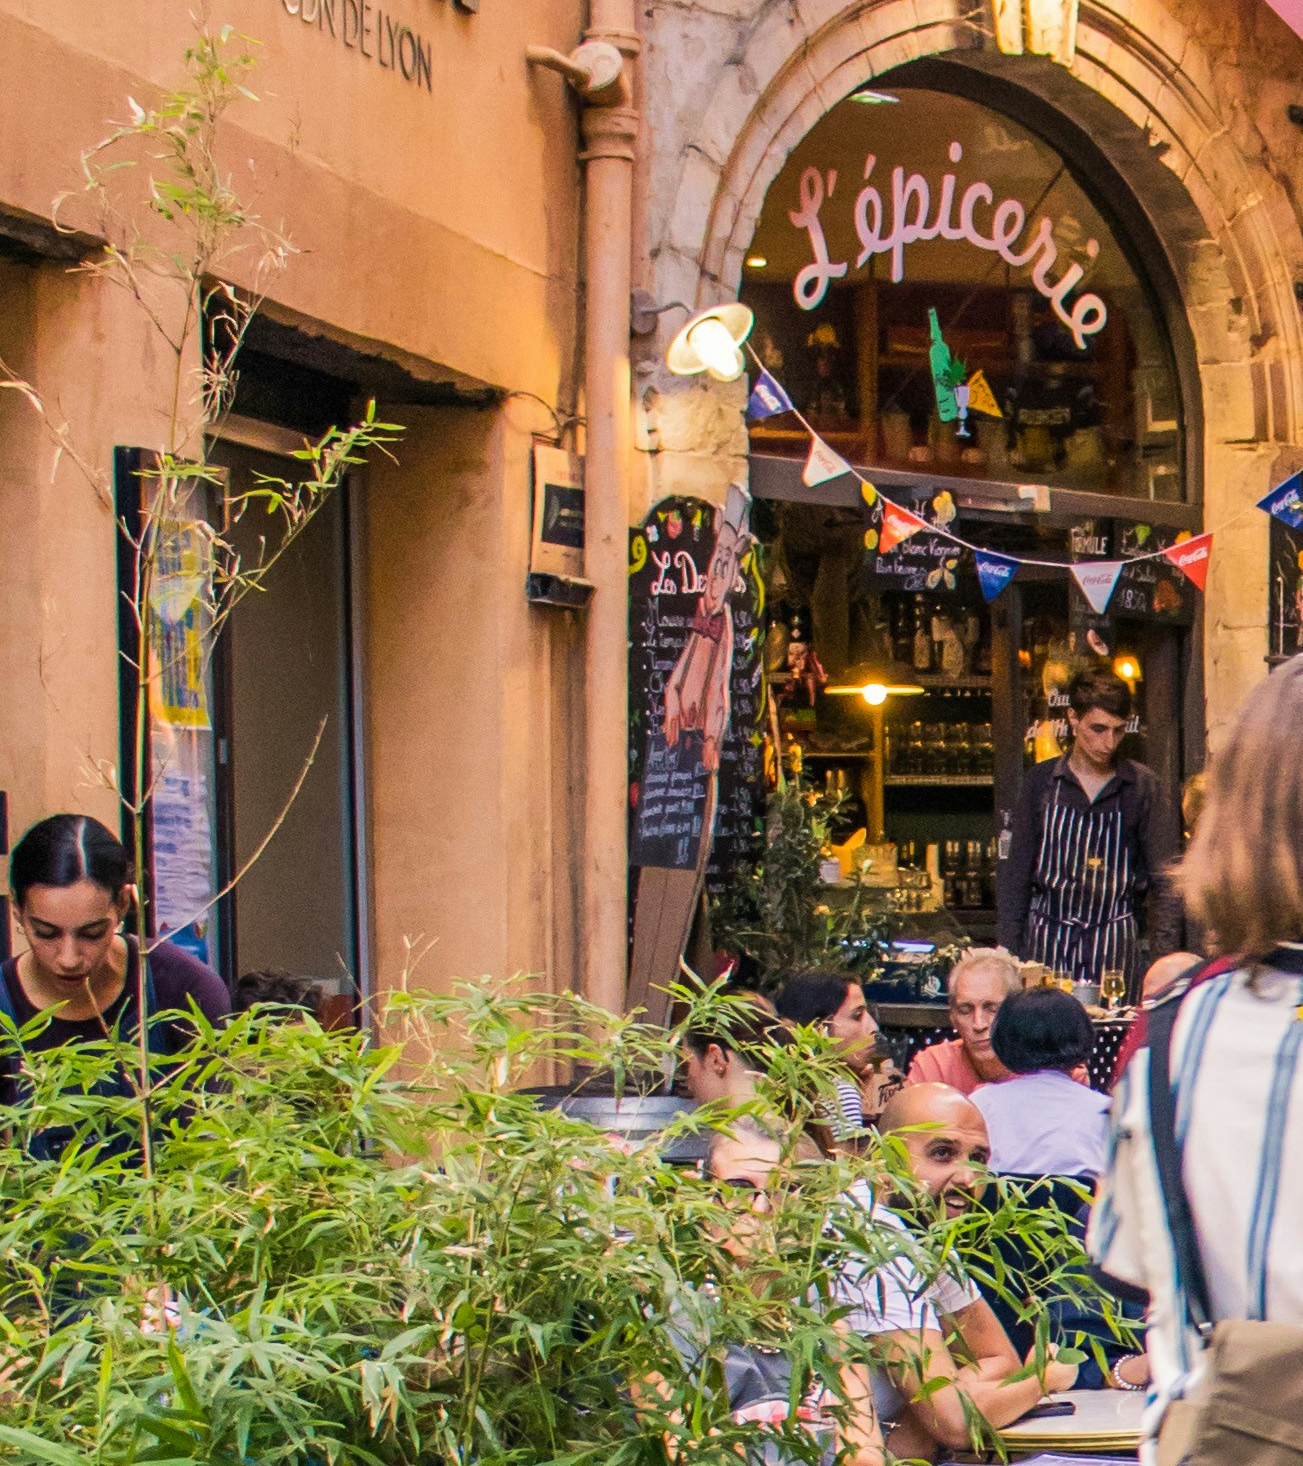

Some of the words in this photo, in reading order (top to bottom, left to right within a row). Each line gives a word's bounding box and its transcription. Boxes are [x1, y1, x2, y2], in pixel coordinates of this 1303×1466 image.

[377, 8, 432, 93] LYON
[789, 141, 1107, 350] L'épicerie
[1178, 546, 1209, 567] Coca-Cola
